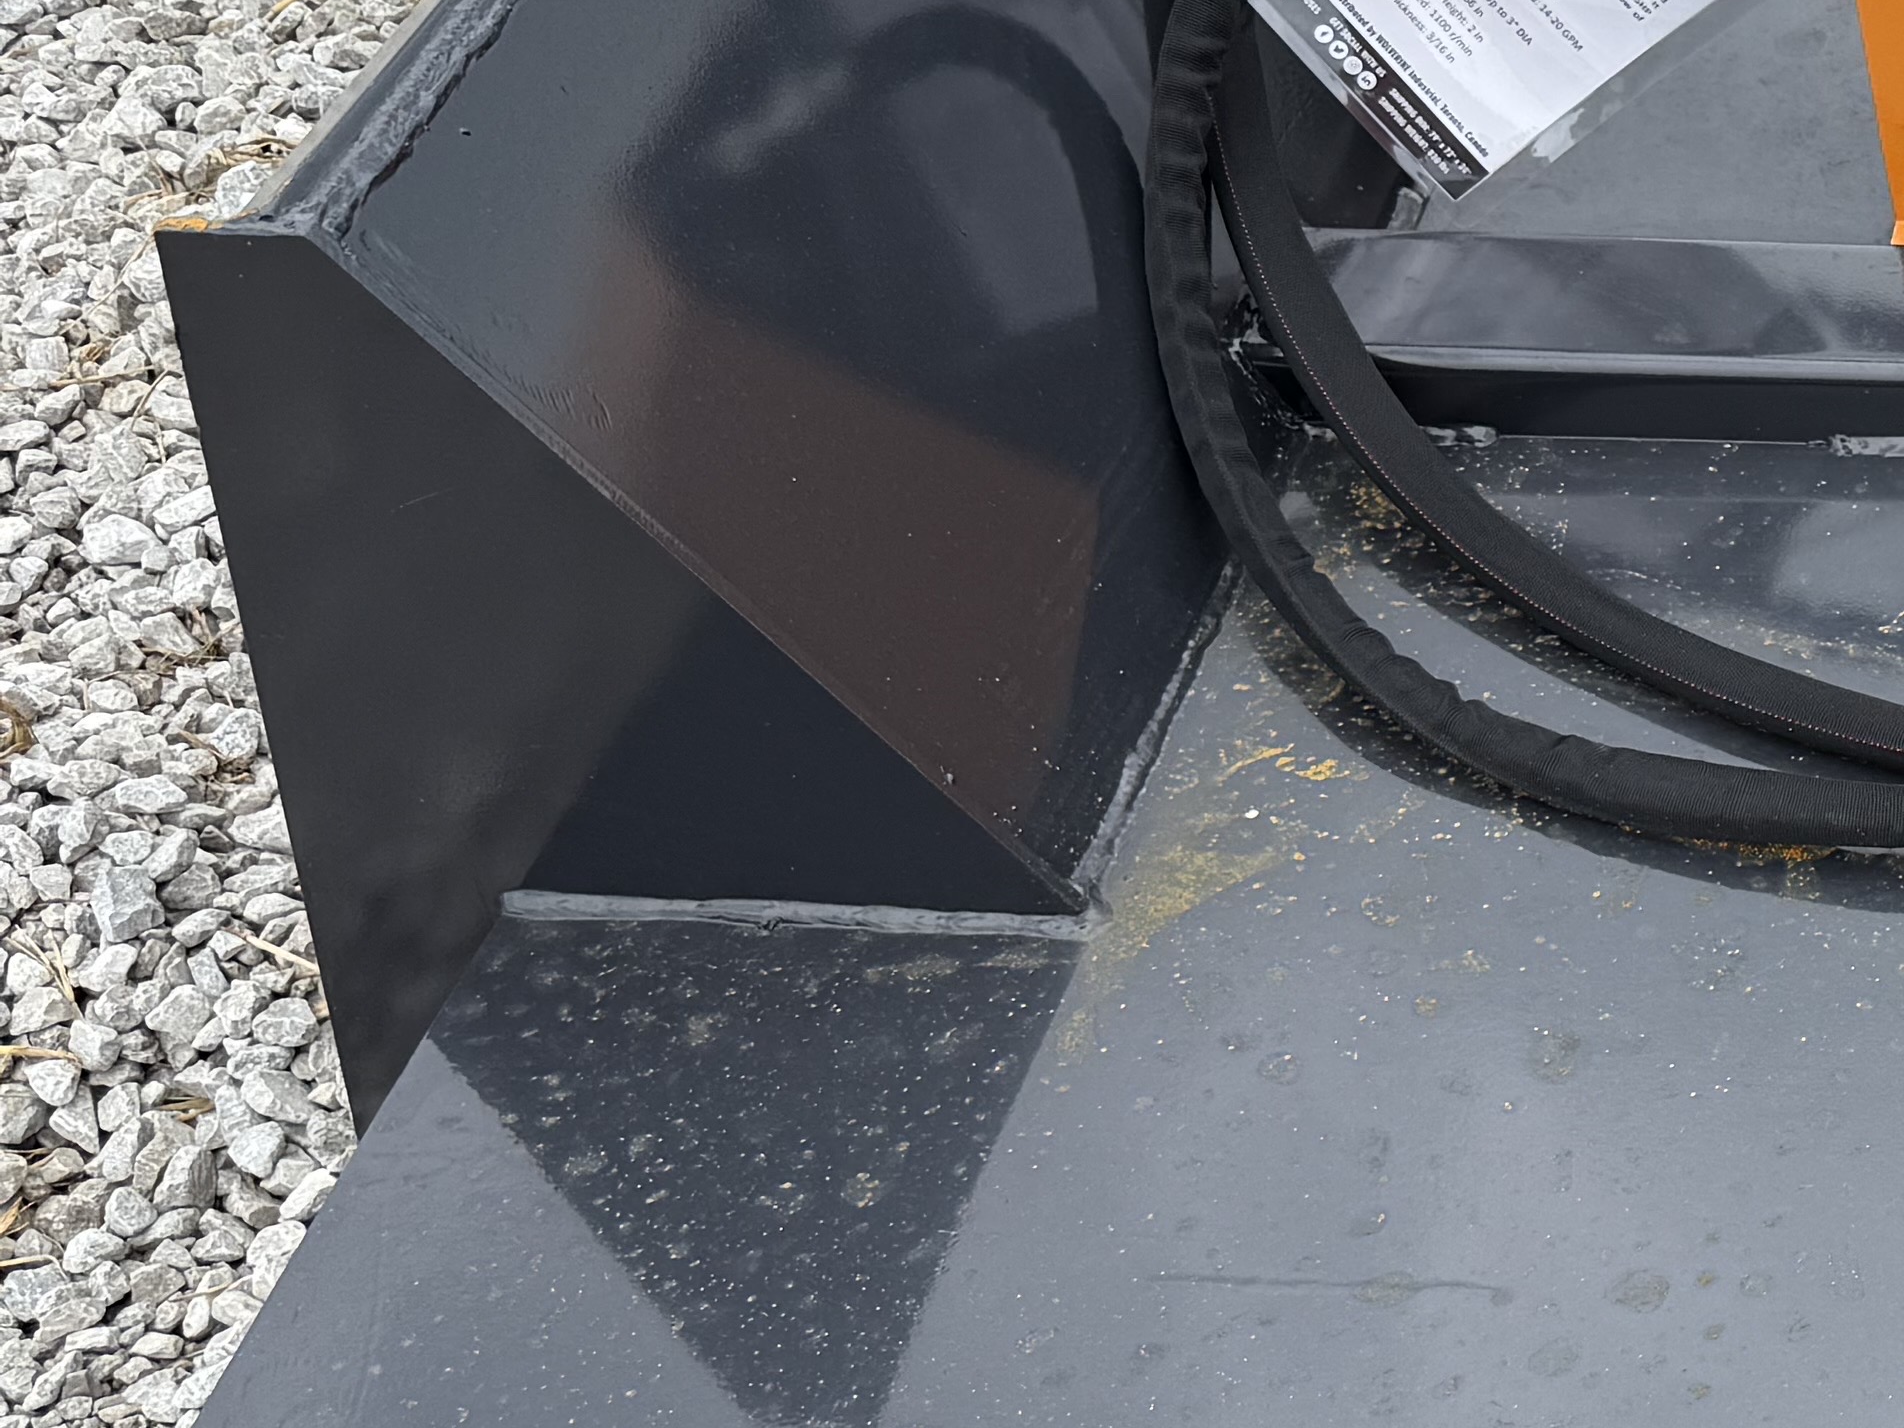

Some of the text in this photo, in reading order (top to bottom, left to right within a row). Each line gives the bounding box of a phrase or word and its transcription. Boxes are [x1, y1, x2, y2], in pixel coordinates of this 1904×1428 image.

[1472, 5, 1487, 18] in
[1495, 5, 1509, 19] to
[1514, 26, 1534, 46] DIA
[1538, 3, 1565, 31] 14-20
[1559, 27, 1584, 52] GPM
[1423, 30, 1449, 56] 3/16
[1443, 51, 1457, 64] in
[1427, 8, 1453, 33] 1100
[1446, 29, 1475, 59] r/min
[1466, 23, 1477, 33] 2
[1472, 30, 1486, 44] in
[1364, 23, 1378, 37] by
[1462, 130, 1491, 159] Canada
